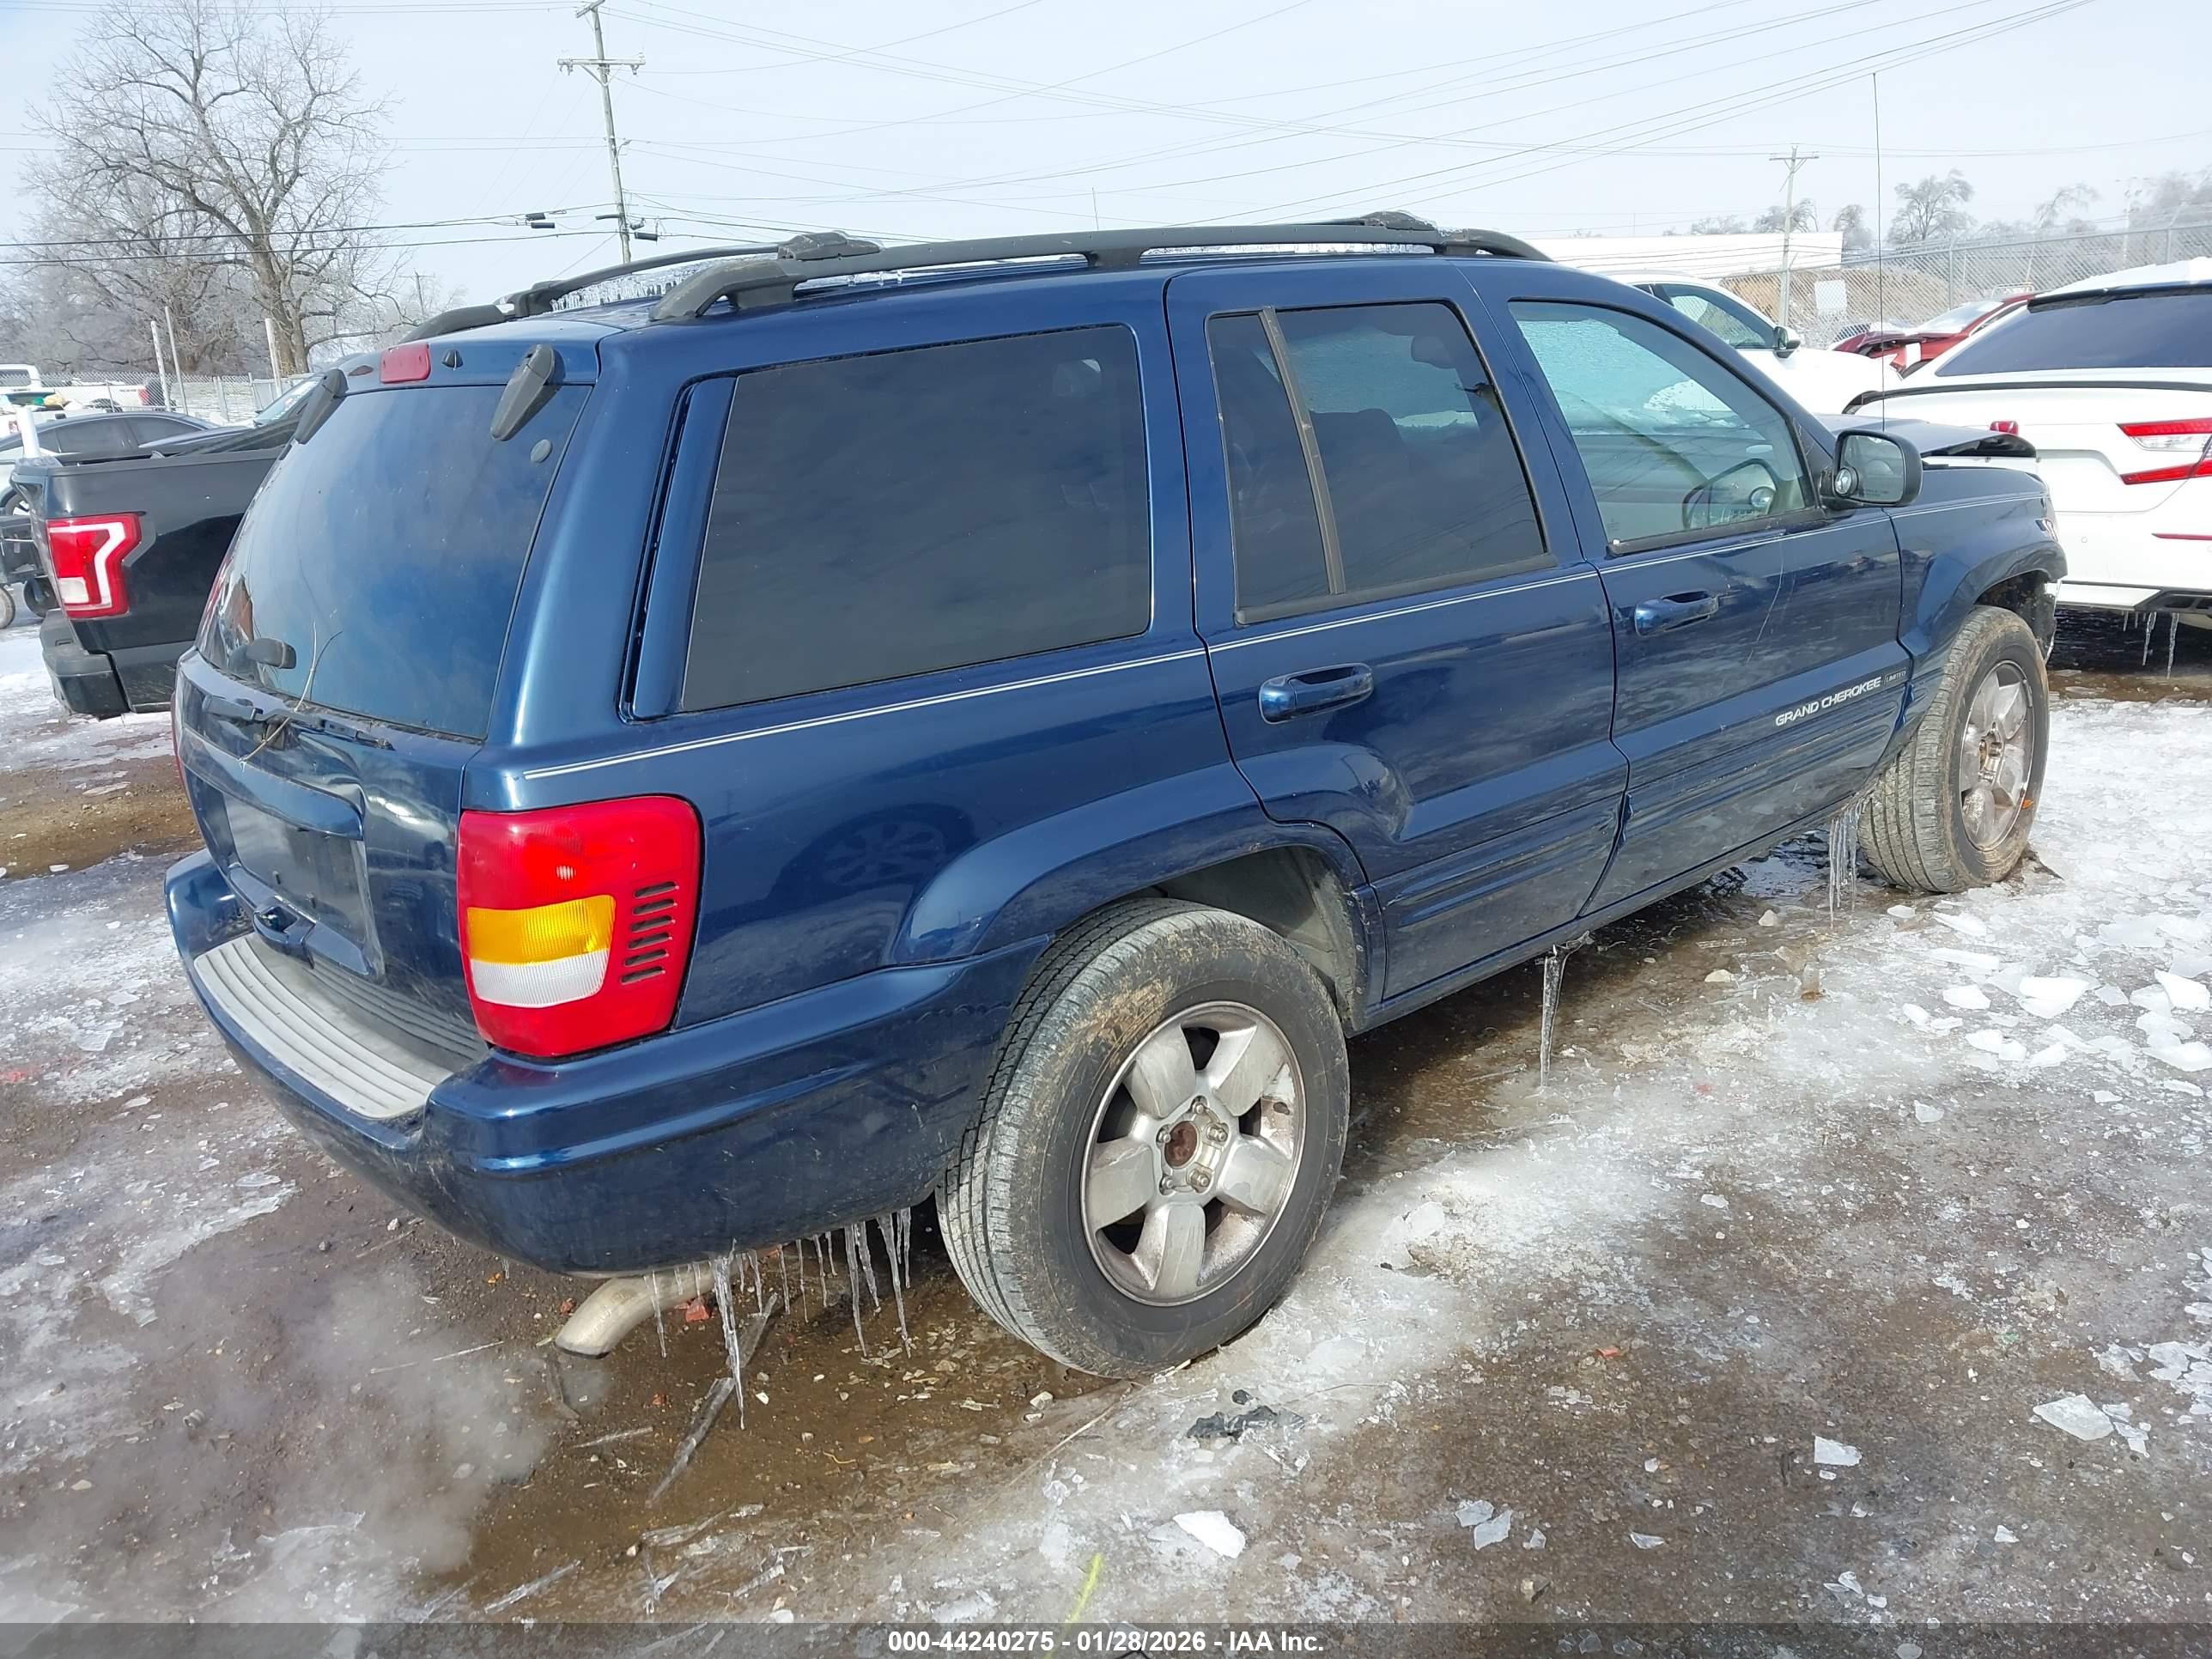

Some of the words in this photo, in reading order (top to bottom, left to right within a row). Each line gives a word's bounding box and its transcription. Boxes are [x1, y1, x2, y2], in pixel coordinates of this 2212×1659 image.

[1775, 701, 1820, 726] GRAND
[1821, 676, 1882, 708] CHEROKEE
[1886, 670, 1906, 683] LIMITED
